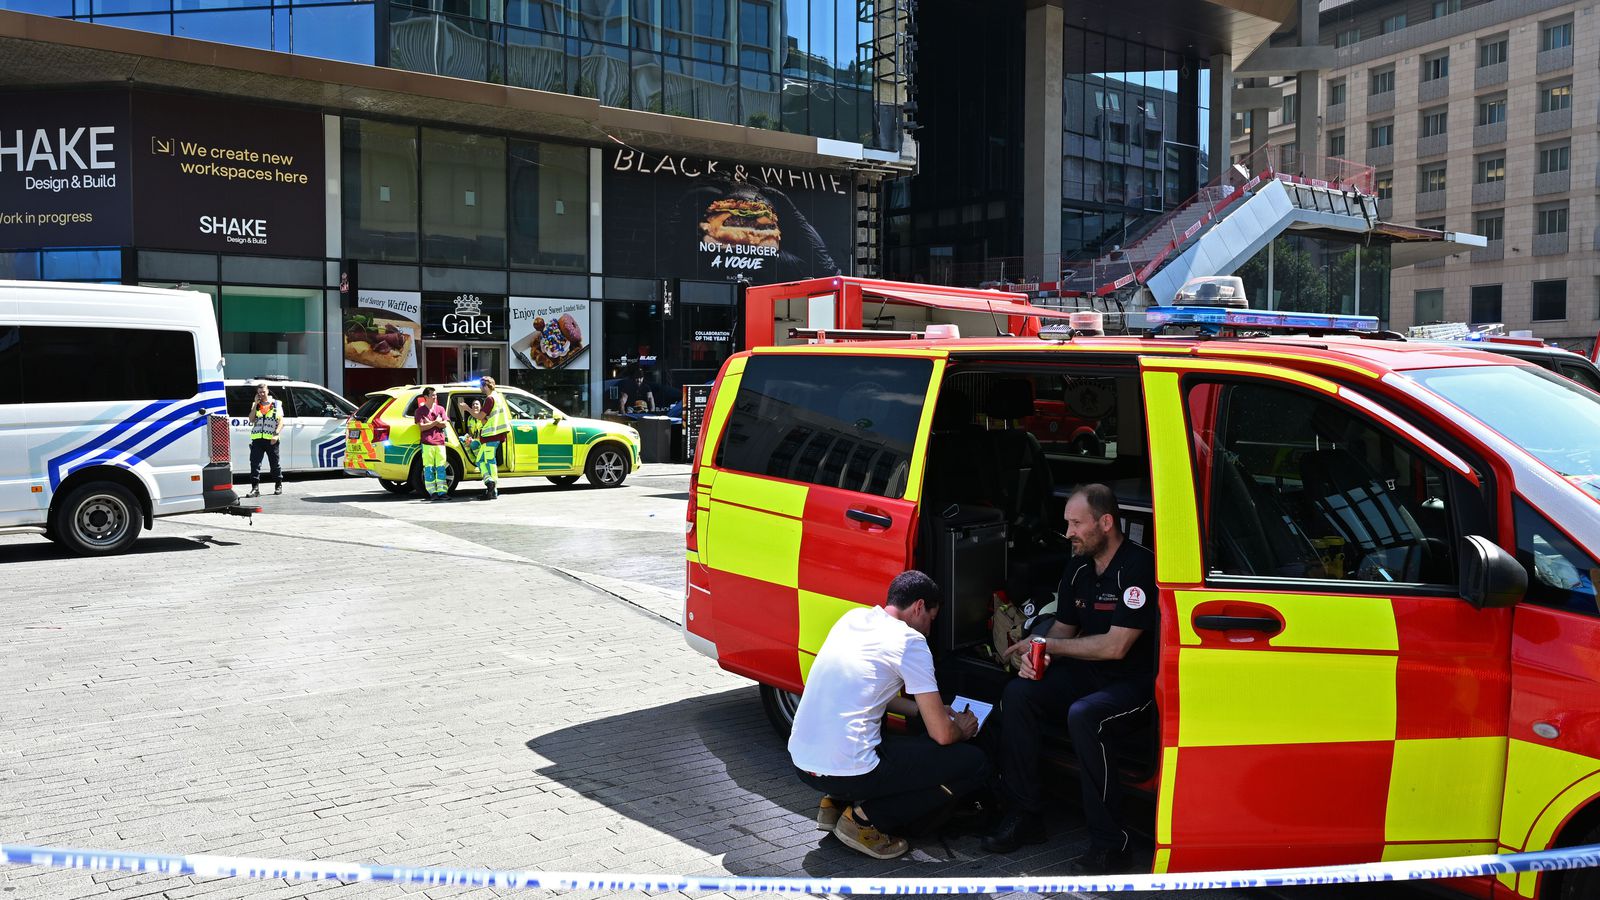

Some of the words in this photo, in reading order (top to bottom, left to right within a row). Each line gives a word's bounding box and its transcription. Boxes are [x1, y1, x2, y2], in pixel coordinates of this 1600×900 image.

[181, 141, 207, 157] We
[210, 148, 259, 162] create
[262, 153, 293, 166] new
[181, 162, 273, 181] workspaces
[275, 169, 308, 184] here
[613, 149, 720, 178] BLACK
[734, 164, 749, 182] &
[761, 166, 847, 195] WHITE
[25, 176, 69, 192] Design
[70, 175, 82, 189] &
[83, 174, 116, 188] Build
[25, 212, 36, 223] in
[38, 212, 93, 226] progress
[199, 215, 267, 237] SHAKE
[226, 236, 247, 245] Design
[699, 241, 722, 253] NOT
[725, 243, 733, 254] A
[735, 244, 780, 258] BURGER,
[711, 255, 723, 269] A
[724, 256, 764, 270] VOGUE
[387, 299, 418, 314] Waffles
[512, 308, 536, 320] Enjoy
